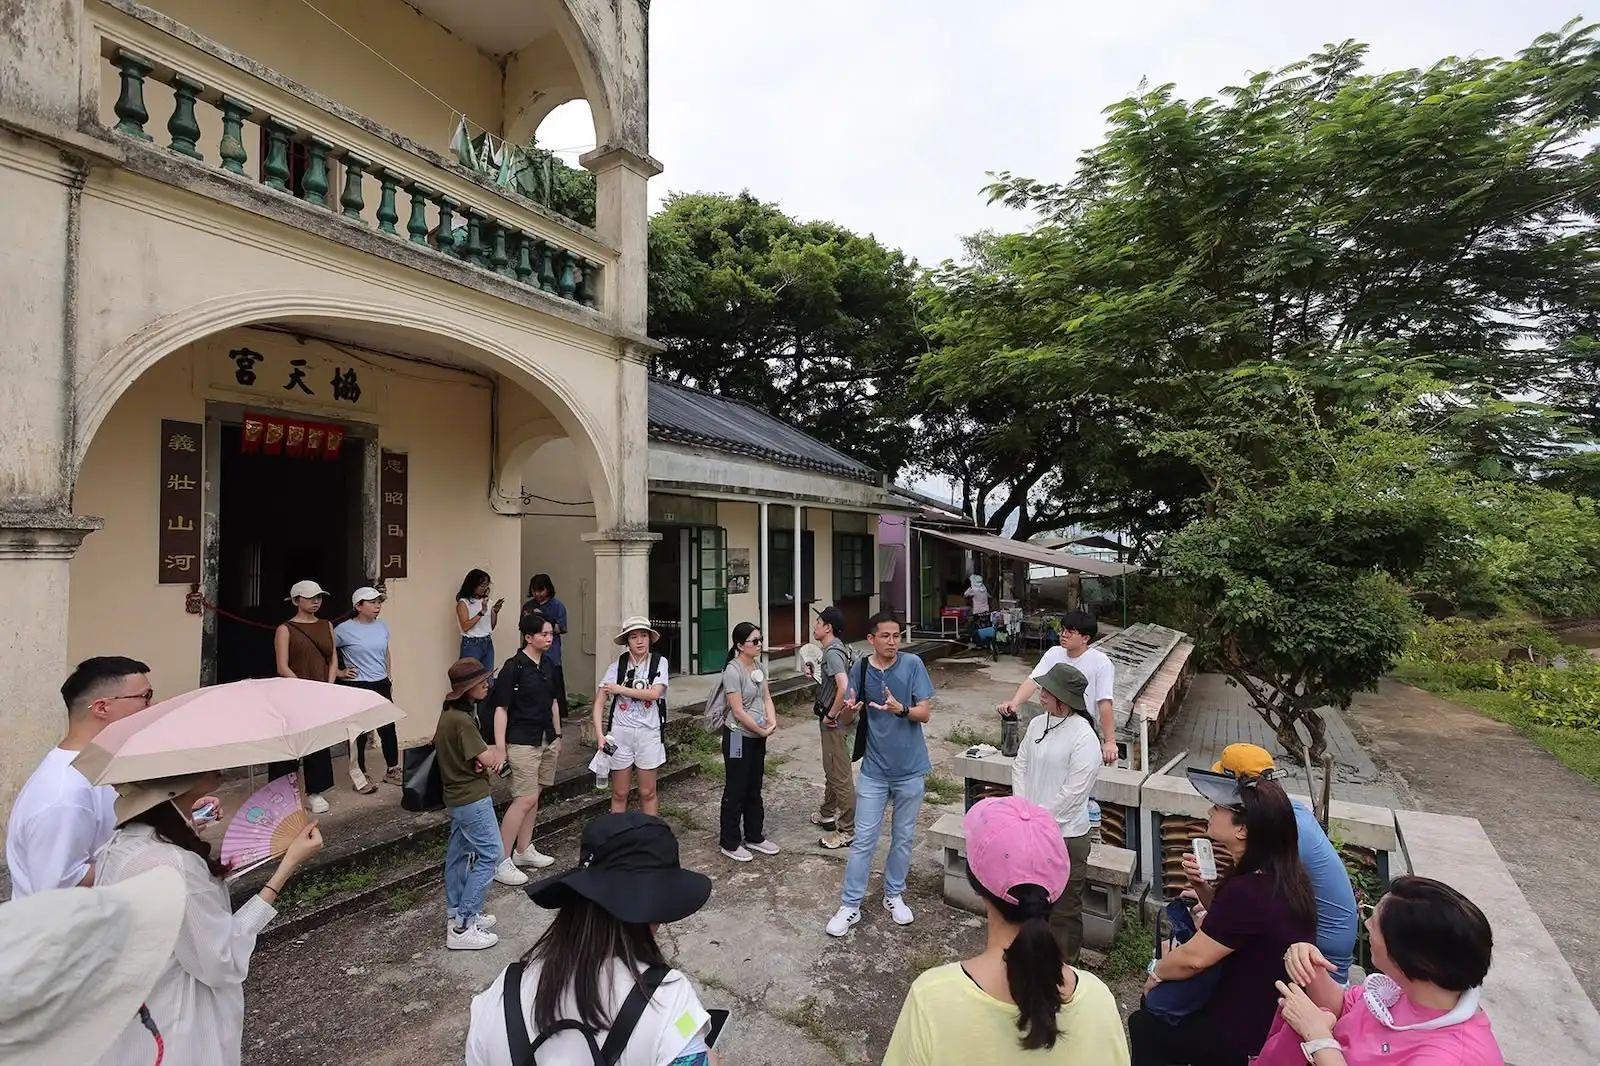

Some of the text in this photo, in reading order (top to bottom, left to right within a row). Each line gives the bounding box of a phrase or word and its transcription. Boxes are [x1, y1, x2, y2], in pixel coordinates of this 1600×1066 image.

[165, 433, 196, 571] 義壯山河
[384, 459, 404, 569] 忠昭日月
